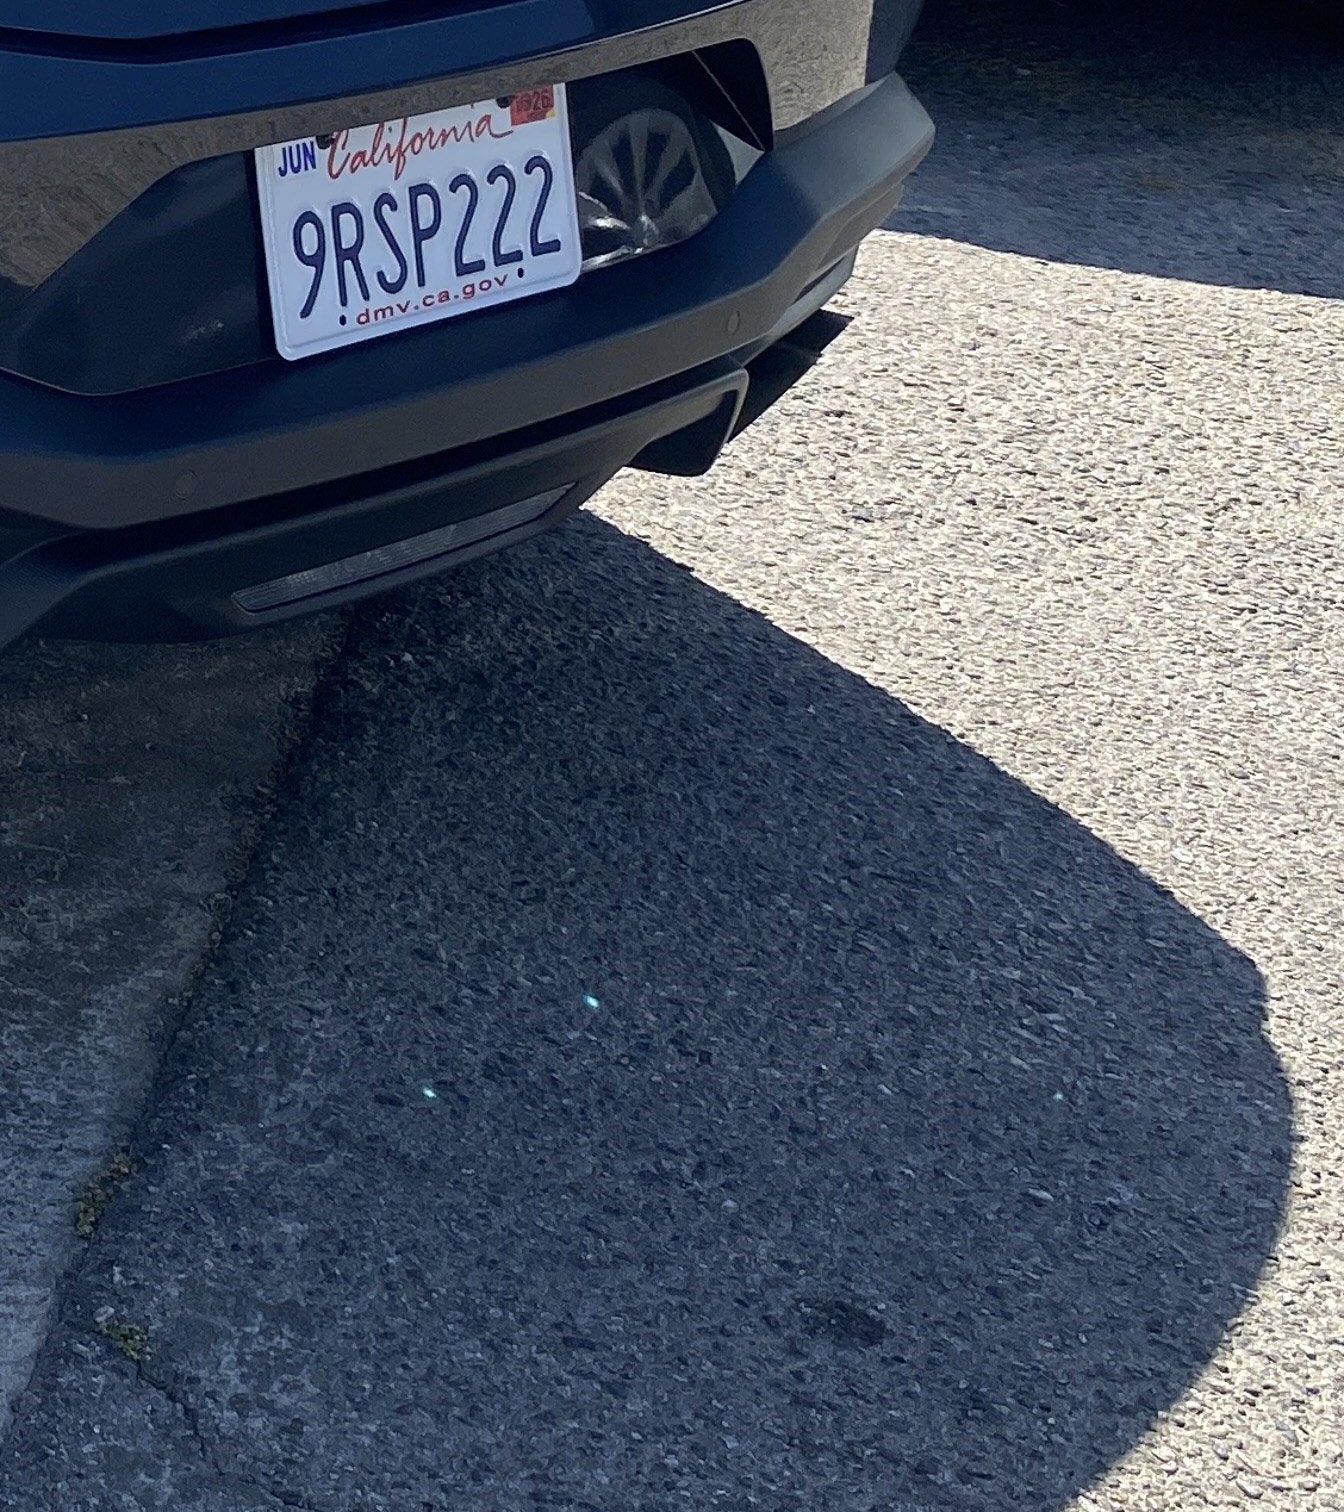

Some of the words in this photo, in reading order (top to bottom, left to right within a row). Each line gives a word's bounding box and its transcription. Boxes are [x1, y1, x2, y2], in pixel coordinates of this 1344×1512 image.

[278, 141, 317, 178] JUN
[327, 105, 513, 180] California
[293, 155, 561, 319] 9RSP222
[356, 274, 508, 325] dmv.ca.gov
